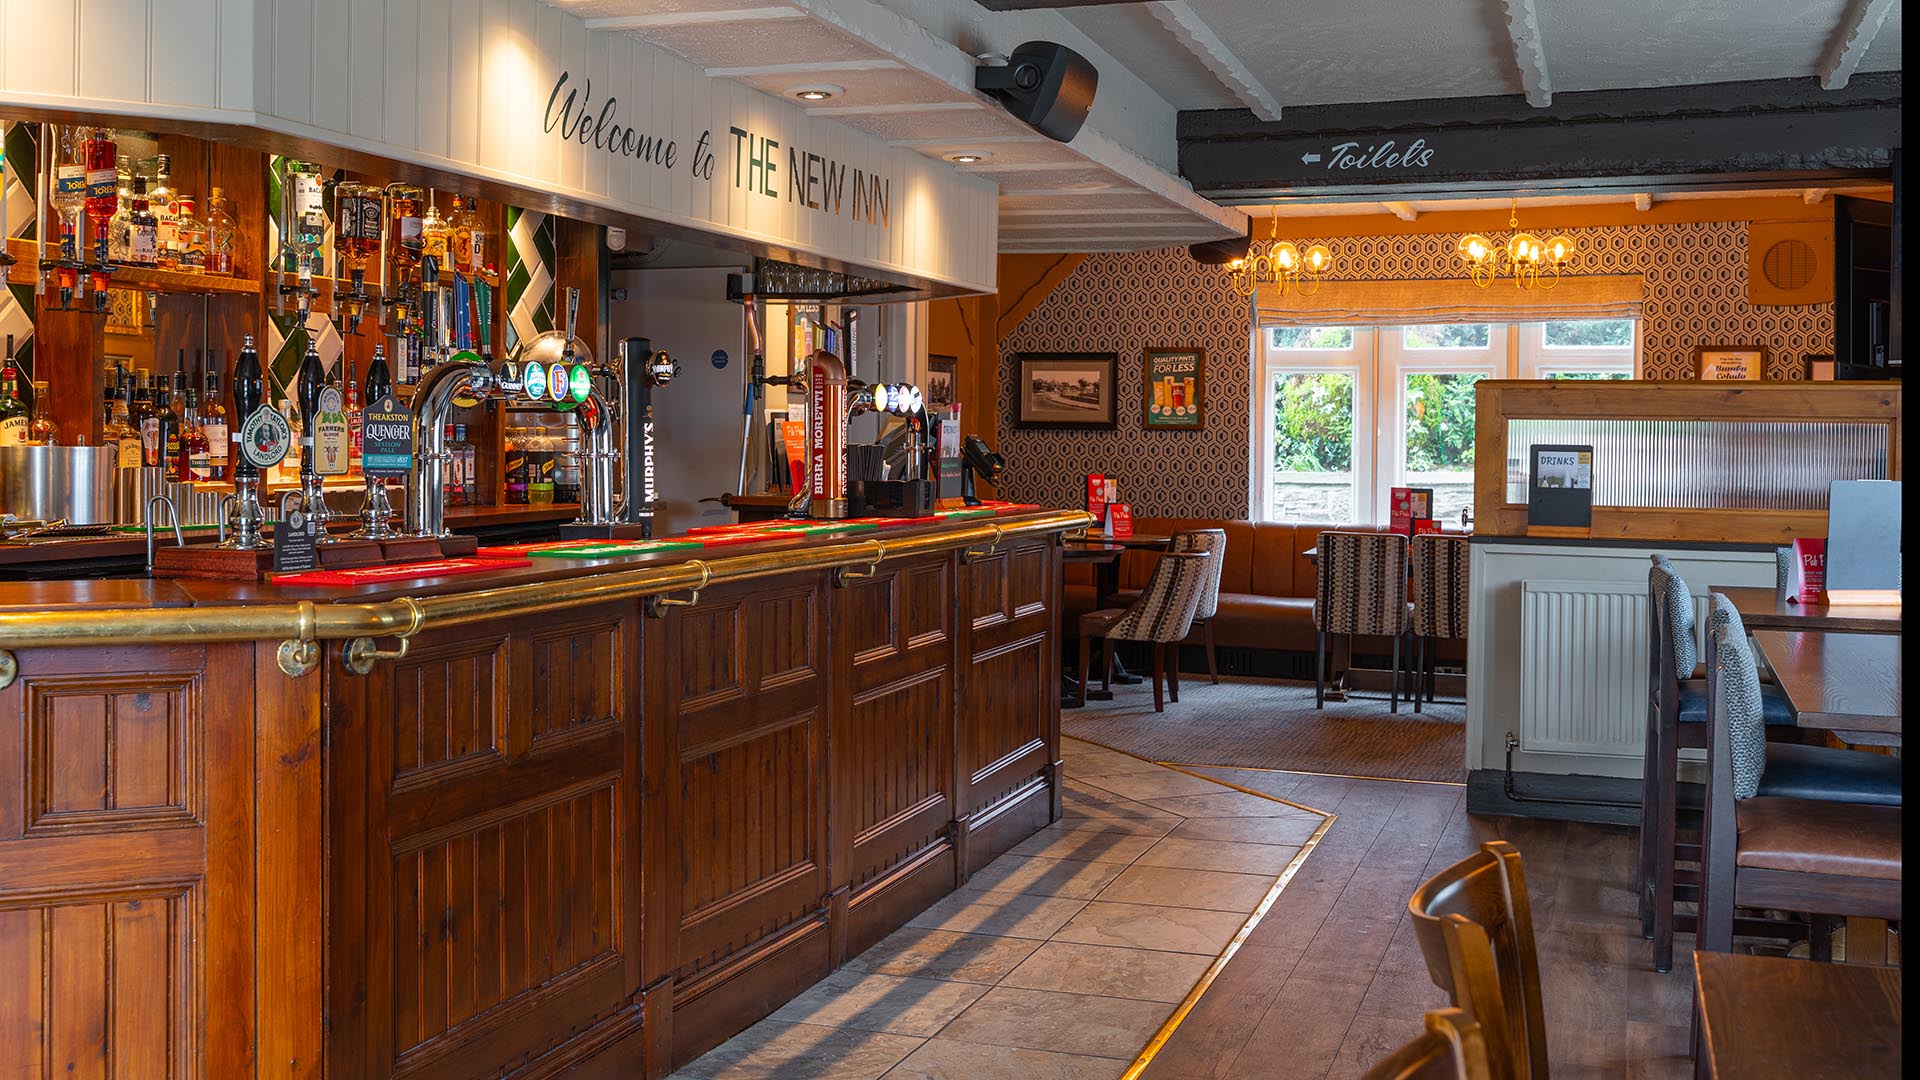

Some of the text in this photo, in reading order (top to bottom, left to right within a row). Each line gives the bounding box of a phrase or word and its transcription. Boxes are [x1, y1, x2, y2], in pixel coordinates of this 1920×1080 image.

[544, 70, 890, 230] Welcome to THE NEW INN
[1327, 138, 1434, 170] Toilets
[1153, 363, 1195, 374] FOR LESS
[246, 414, 263, 443] TIMOTHY
[270, 413, 288, 440] TAYLOR'S
[366, 423, 411, 442] QUENCHER
[368, 413, 409, 422] THEAKSTON
[814, 389, 824, 449] MORETTI
[252, 445, 284, 460] LANDLORD
[644, 422, 655, 503] MURPHY'S
[1540, 456, 1575, 466] DRINKS
[814, 453, 824, 495] BIRRA
